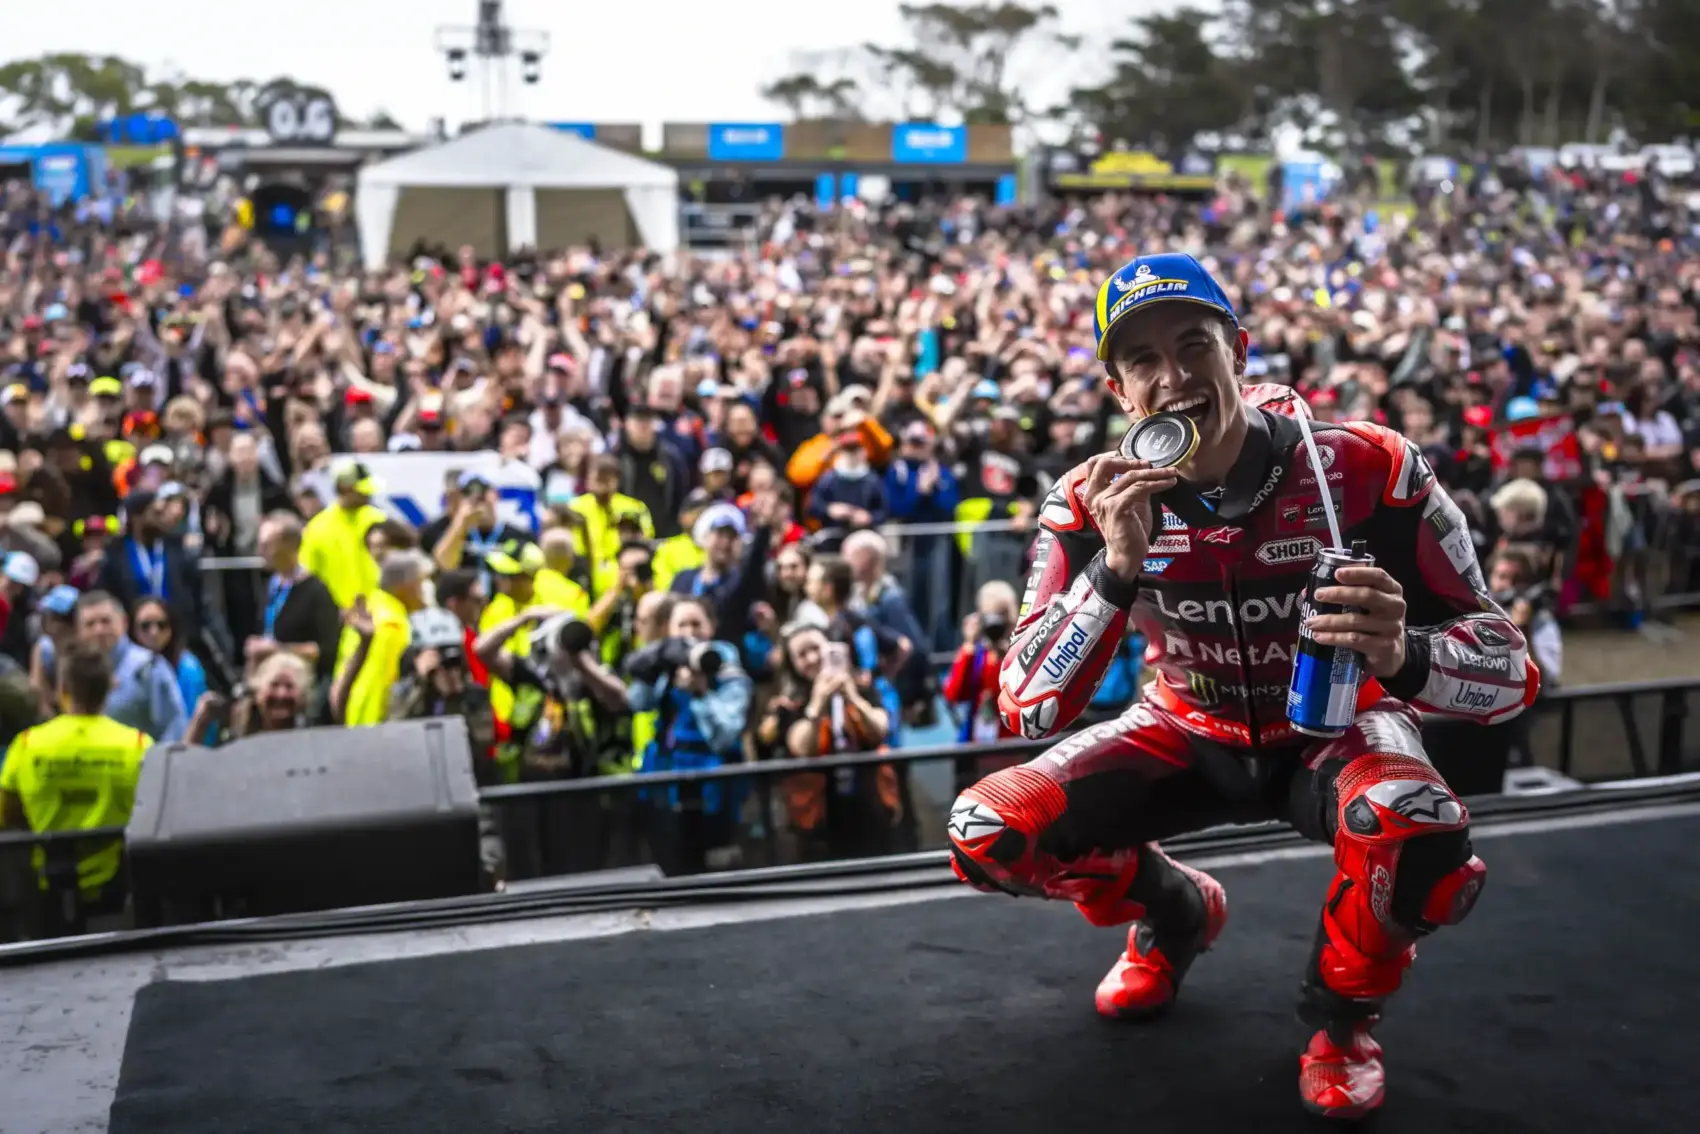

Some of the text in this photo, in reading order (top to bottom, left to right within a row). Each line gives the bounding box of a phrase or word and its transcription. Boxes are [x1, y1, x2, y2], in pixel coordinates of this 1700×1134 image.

[1110, 282, 1189, 323] MICHELIN
[1266, 541, 1314, 560] SHOEI
[1143, 561, 1168, 572] SAP
[1020, 610, 1062, 666] Lenovo
[1042, 621, 1088, 679] Unipol
[1460, 647, 1508, 671] Lenovo
[1455, 682, 1499, 711] Unipol
